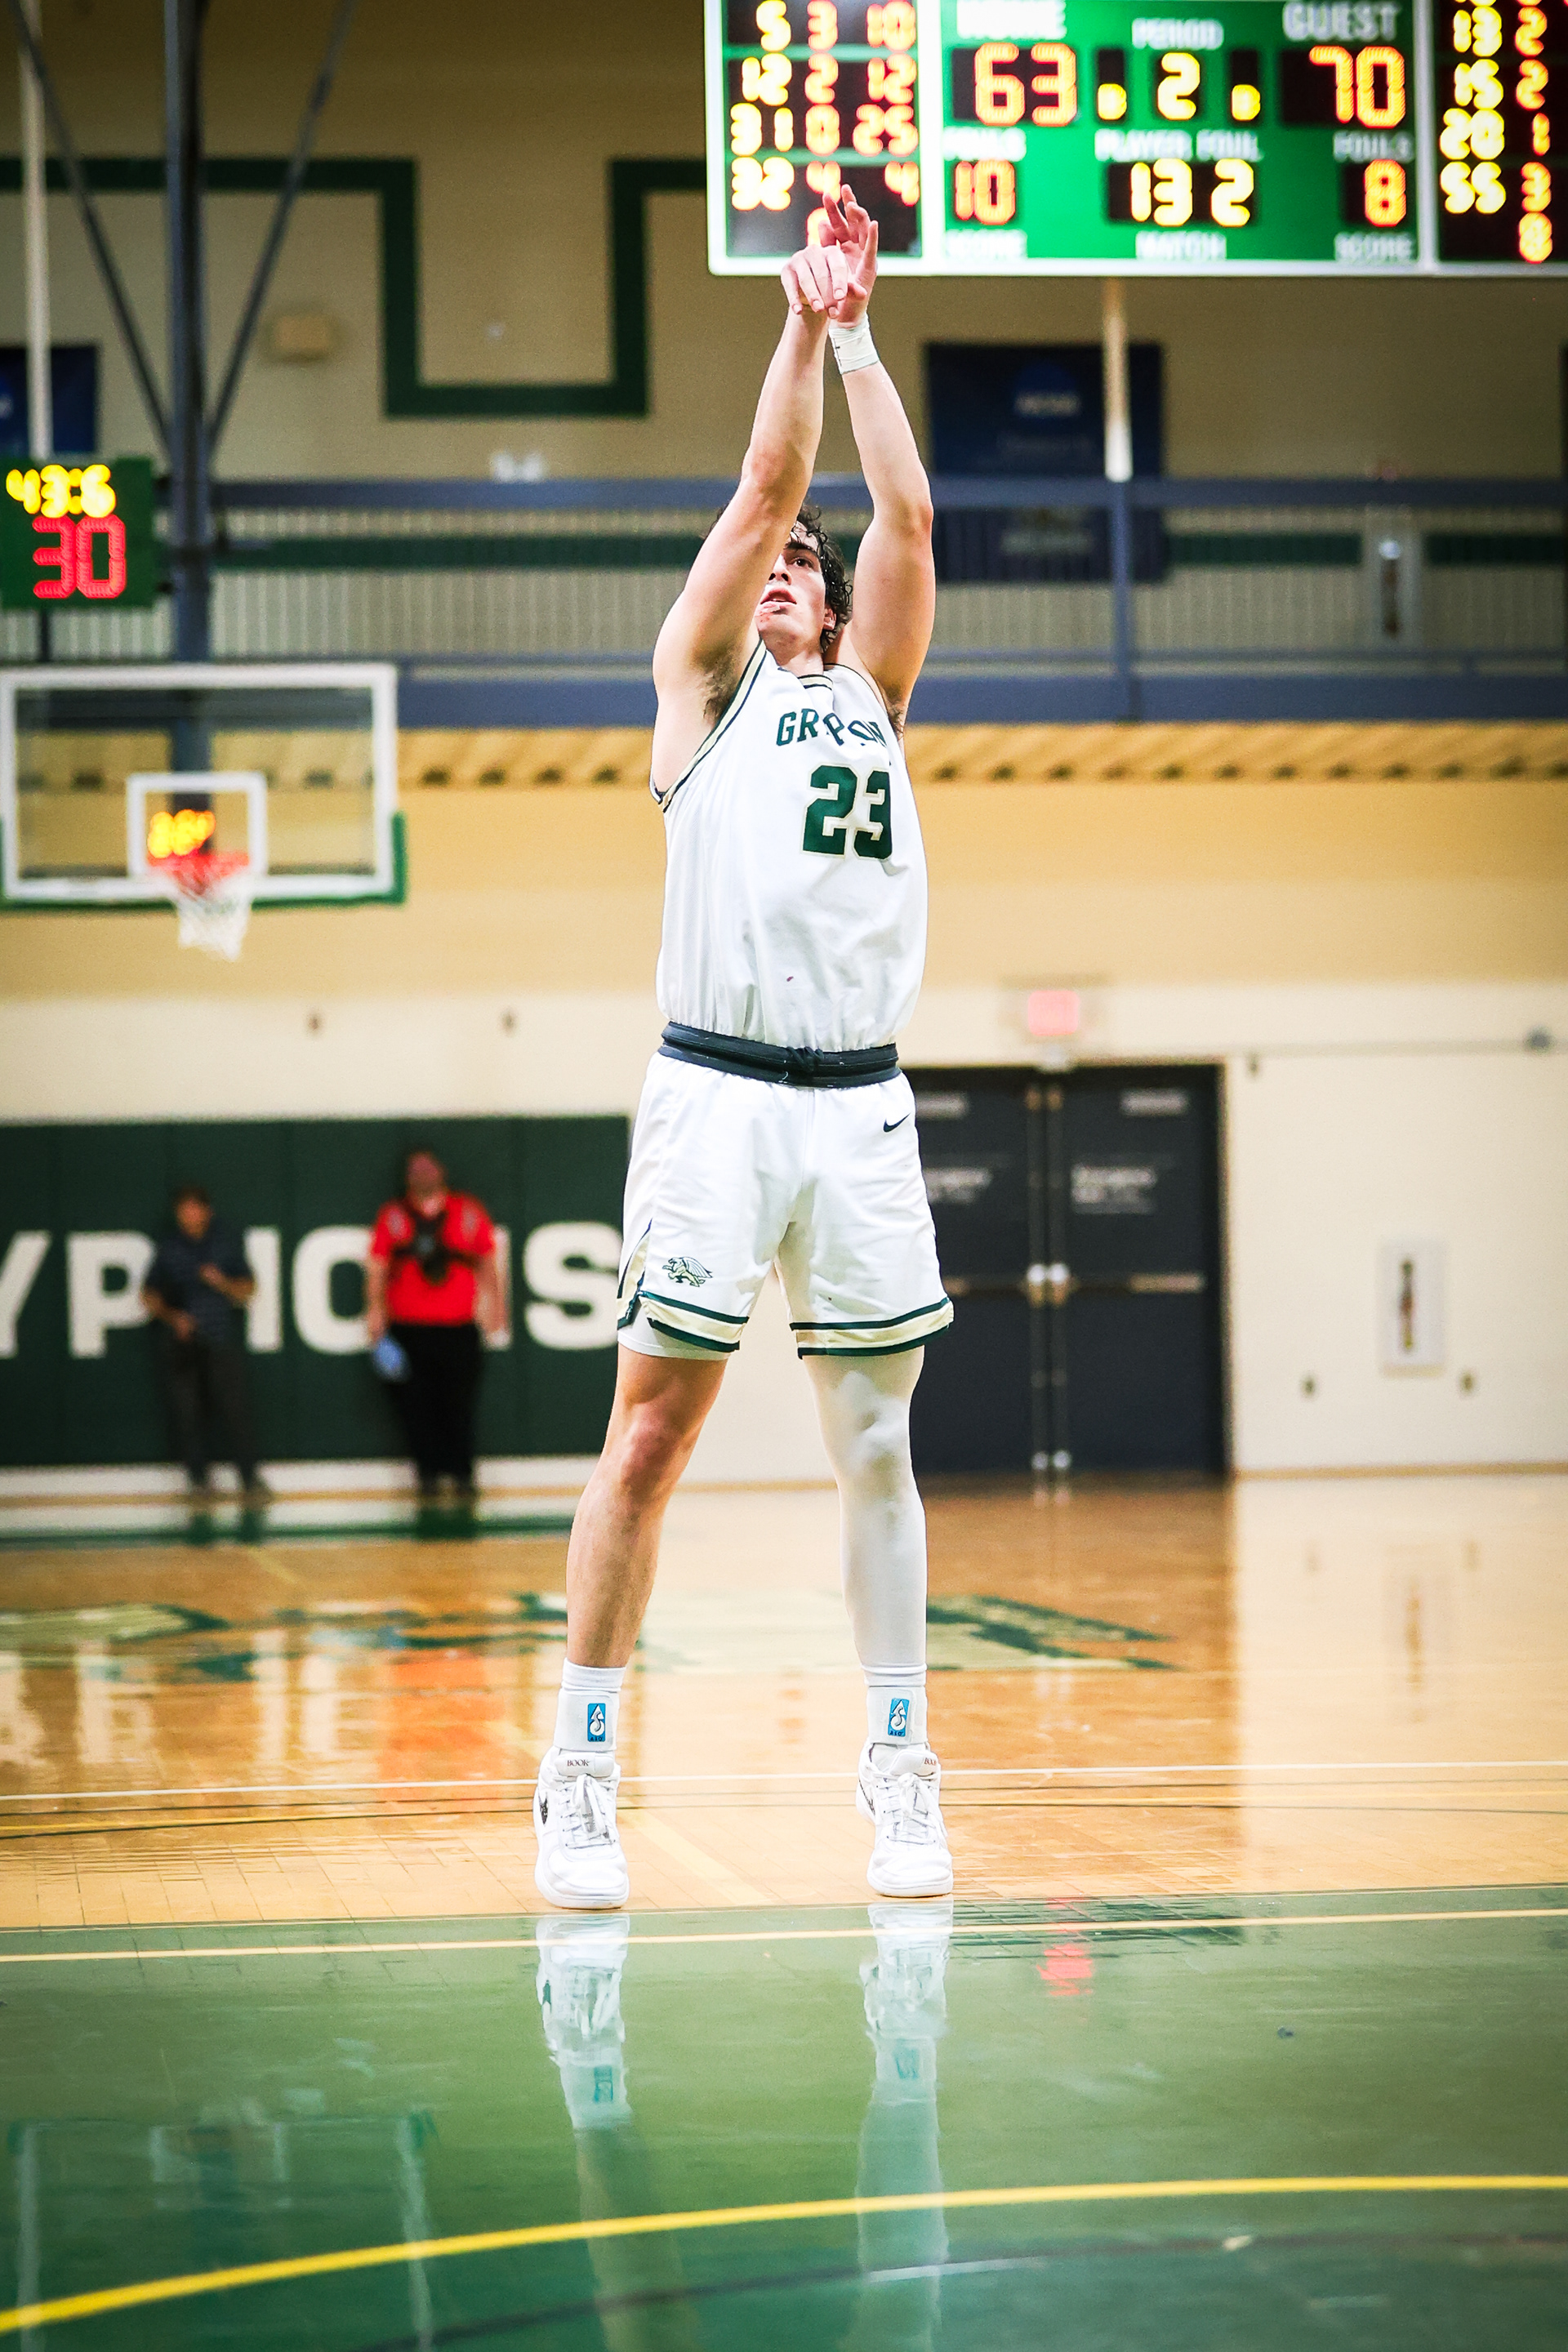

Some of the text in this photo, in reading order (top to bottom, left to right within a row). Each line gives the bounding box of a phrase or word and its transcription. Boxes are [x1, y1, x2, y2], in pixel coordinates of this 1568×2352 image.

[1132, 18, 1224, 49] PERIOD
[1283, 2, 1399, 41] GUEST
[1454, 6, 1547, 57] 13 2
[742, 53, 917, 105] 12 2 12
[974, 42, 1077, 127] 63
[1157, 52, 1200, 121] 2
[1309, 46, 1405, 128] 70
[1454, 59, 1548, 110] 15 2
[805, 105, 840, 157] 0
[852, 105, 919, 157] 25
[1440, 108, 1550, 160] 20 1
[732, 156, 794, 211] 32
[884, 161, 919, 207] 4
[955, 159, 1015, 225] 10
[1130, 158, 1254, 226] 13 2
[1364, 158, 1406, 227] 8
[1440, 162, 1551, 214] 55 3
[1519, 212, 1552, 264] 8
[32, 514, 127, 599] 30
[803, 764, 892, 859] 23
